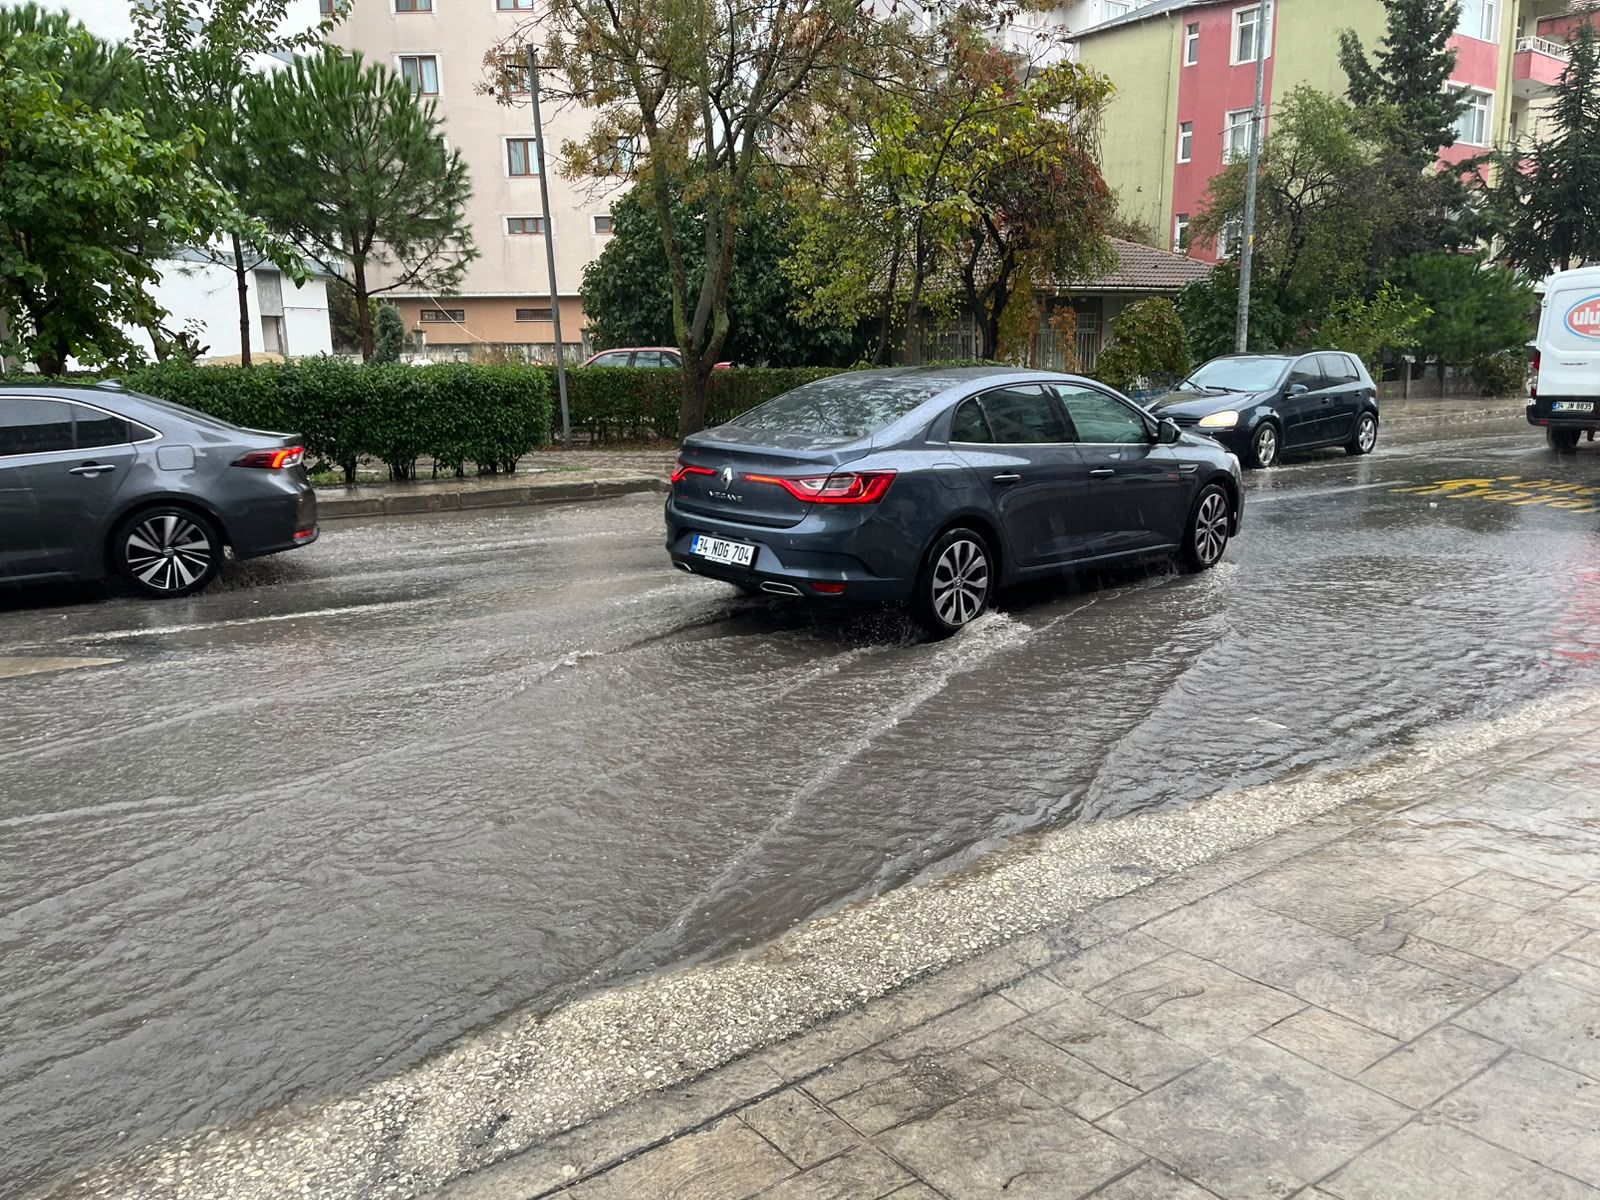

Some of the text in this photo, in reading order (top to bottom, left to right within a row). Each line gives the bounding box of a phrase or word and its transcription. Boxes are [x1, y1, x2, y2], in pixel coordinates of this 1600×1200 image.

[697, 538, 708, 553] 34
[711, 540, 730, 558] NDG
[731, 545, 749, 562] 704
